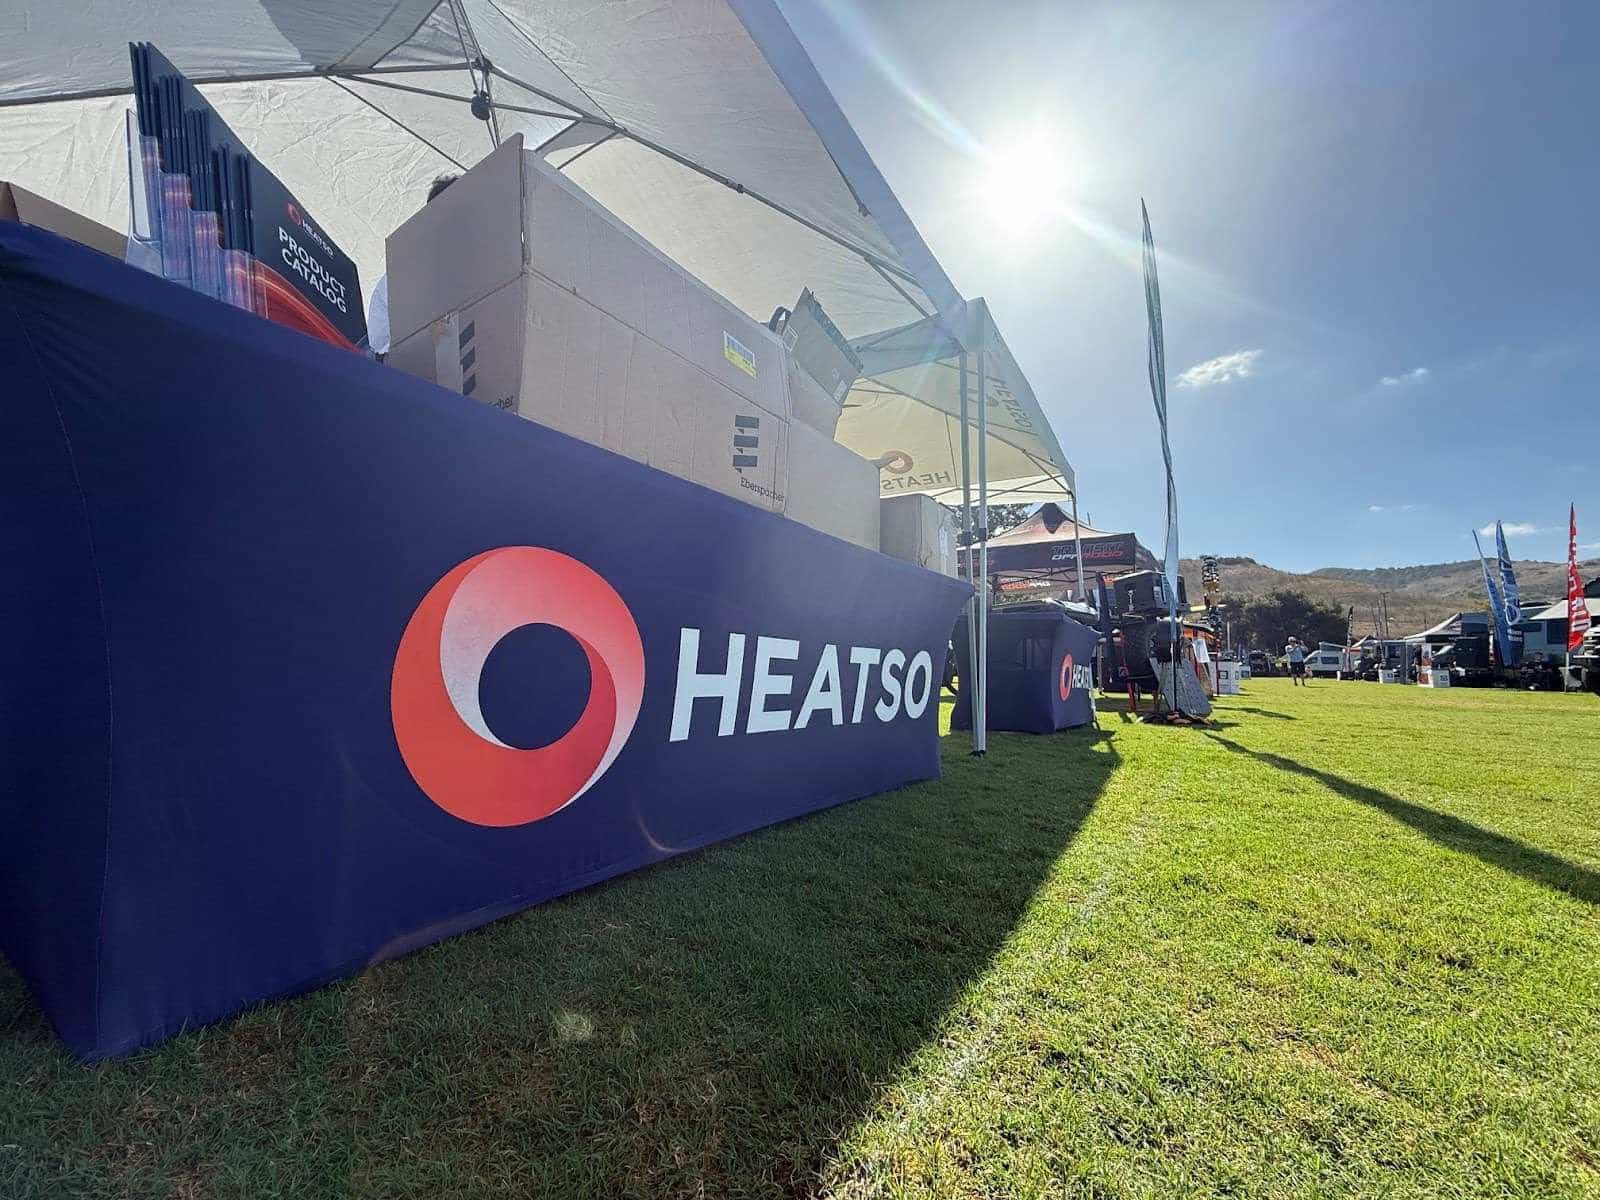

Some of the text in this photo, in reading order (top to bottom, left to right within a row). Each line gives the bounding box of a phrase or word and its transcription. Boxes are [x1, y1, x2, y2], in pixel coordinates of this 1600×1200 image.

[279, 226, 346, 297] PRODUCT
[302, 219, 334, 257] HEATSO
[282, 248, 347, 313] CATALOG
[669, 627, 933, 742] HEATSO
